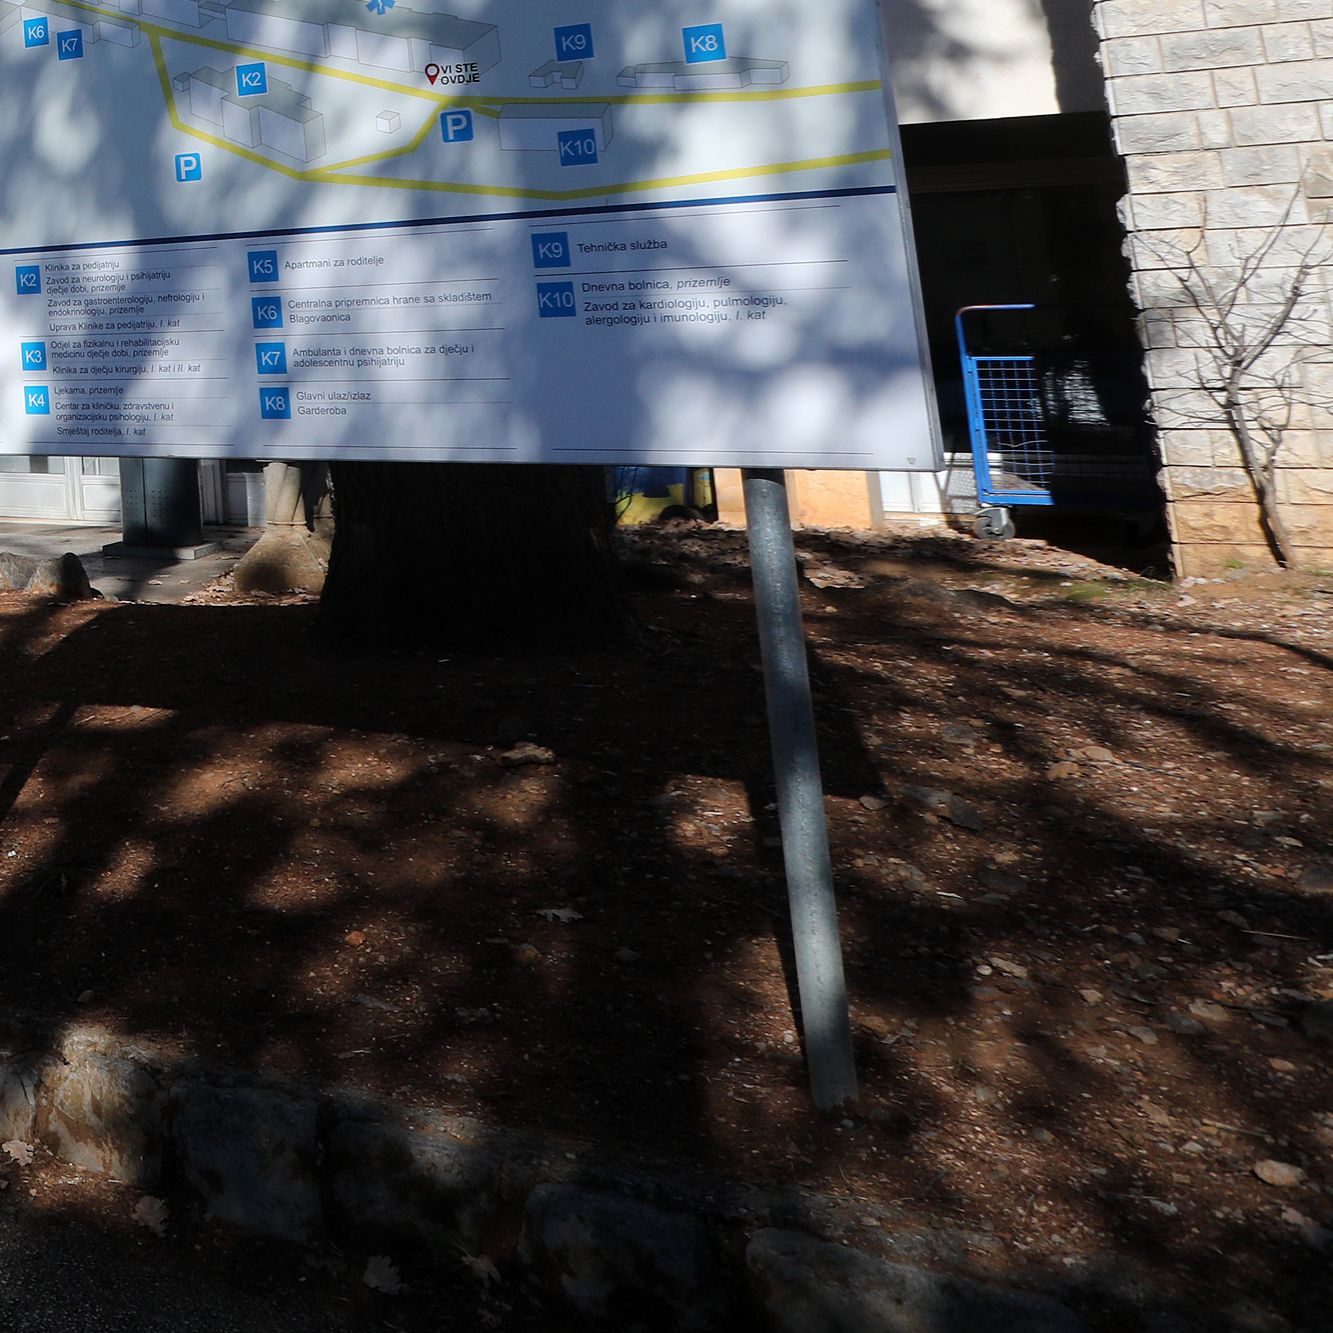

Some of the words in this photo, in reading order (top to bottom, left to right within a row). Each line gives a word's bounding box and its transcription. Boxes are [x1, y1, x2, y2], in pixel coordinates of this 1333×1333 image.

[28, 26, 44, 40] K6
[62, 38, 78, 51] K7
[562, 34, 586, 51] K9
[691, 35, 717, 51] K8
[441, 65, 452, 74] VI
[455, 63, 478, 73] STE
[242, 72, 261, 87] K2
[440, 73, 479, 85] OVDJE
[447, 115, 467, 138] P
[560, 139, 594, 155] K10
[180, 156, 197, 179] P
[539, 242, 563, 259] K9
[577, 241, 627, 253] Tehnička
[630, 239, 667, 250] služba
[83, 261, 119, 269] pedijatriju
[253, 260, 273, 274] K5
[285, 259, 331, 270] Apartmani
[333, 258, 345, 266] za
[347, 255, 384, 266] roditelje
[20, 274, 36, 287] K2
[46, 277, 69, 285] Zavod
[82, 274, 124, 283] neurologiju
[131, 271, 170, 280] psihijatriju
[583, 282, 625, 293] Dnevna
[629, 279, 673, 291] bolnica,
[677, 276, 730, 291] prizemlje
[47, 286, 68, 294] dječje
[91, 284, 125, 293] prizemlje
[48, 299, 71, 308] Zavod
[158, 294, 200, 303] nefrologiju
[288, 299, 332, 309] Centralna
[335, 296, 390, 308] pripremnica
[393, 294, 420, 304] hrane
[423, 295, 435, 303] sa
[438, 292, 492, 303] skladištem
[540, 291, 573, 308] K10
[584, 300, 618, 312] Zavod
[622, 301, 636, 310] za
[639, 296, 709, 310] kardiologiju,
[713, 295, 787, 308] pulmologiju,
[110, 306, 144, 315] prizemlje
[258, 306, 277, 320] K6
[289, 313, 351, 324] Blagovaonica
[586, 314, 650, 326] alergologiju
[660, 310, 731, 324] imunologiju,
[747, 310, 765, 321] kat
[49, 323, 76, 332] Uprava
[78, 322, 103, 330] Klinike
[51, 341, 70, 349] Odjel
[83, 339, 114, 348] fizikalnu
[121, 338, 179, 347] rehabilitacijsku
[25, 350, 42, 363] K3
[52, 350, 84, 358] medicinu
[87, 349, 110, 358] dječje
[133, 348, 168, 358] prizemlje
[293, 347, 341, 357] Ambulanta
[349, 346, 384, 356] dnevna
[387, 345, 421, 355] bolnica
[424, 346, 436, 354] za
[439, 344, 468, 356] dječju
[261, 351, 280, 365] K7
[293, 358, 354, 368] adolescentnu
[357, 357, 405, 368] psihijatriju
[53, 366, 77, 374] Klinika
[90, 365, 113, 375] dječju
[28, 394, 45, 406] K4
[296, 391, 325, 401] Glavni
[328, 391, 371, 401] ulaz/izlaz
[55, 402, 79, 410] Centar
[123, 402, 169, 410] zdravstvenu
[265, 396, 285, 410] K8
[56, 413, 107, 422] organizacijsku
[161, 413, 173, 421] kat
[298, 406, 347, 416] Garderoba
[57, 426, 89, 436] Smještaj
[134, 427, 146, 435] kat
